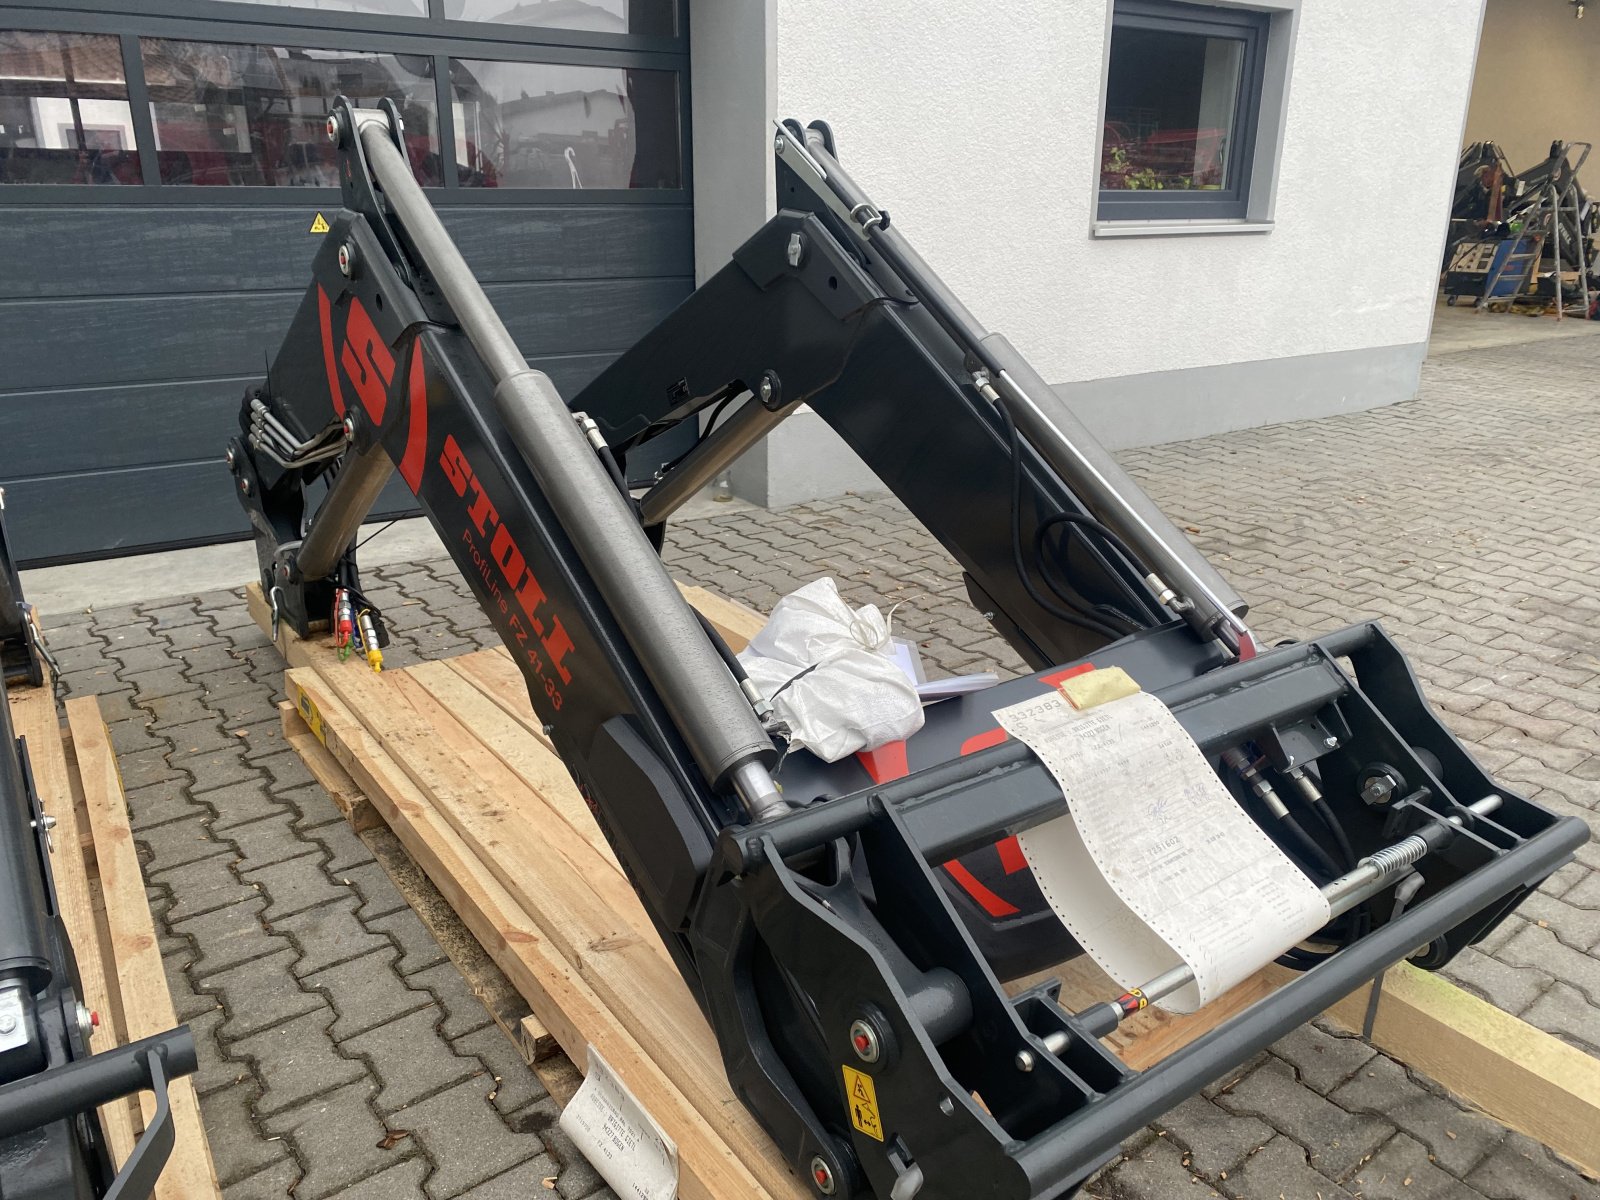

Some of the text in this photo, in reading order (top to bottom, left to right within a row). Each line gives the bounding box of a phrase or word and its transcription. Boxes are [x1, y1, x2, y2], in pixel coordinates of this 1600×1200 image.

[439, 434, 575, 686] STOLL
[462, 529, 563, 711] ProfiLine FZ 41-33
